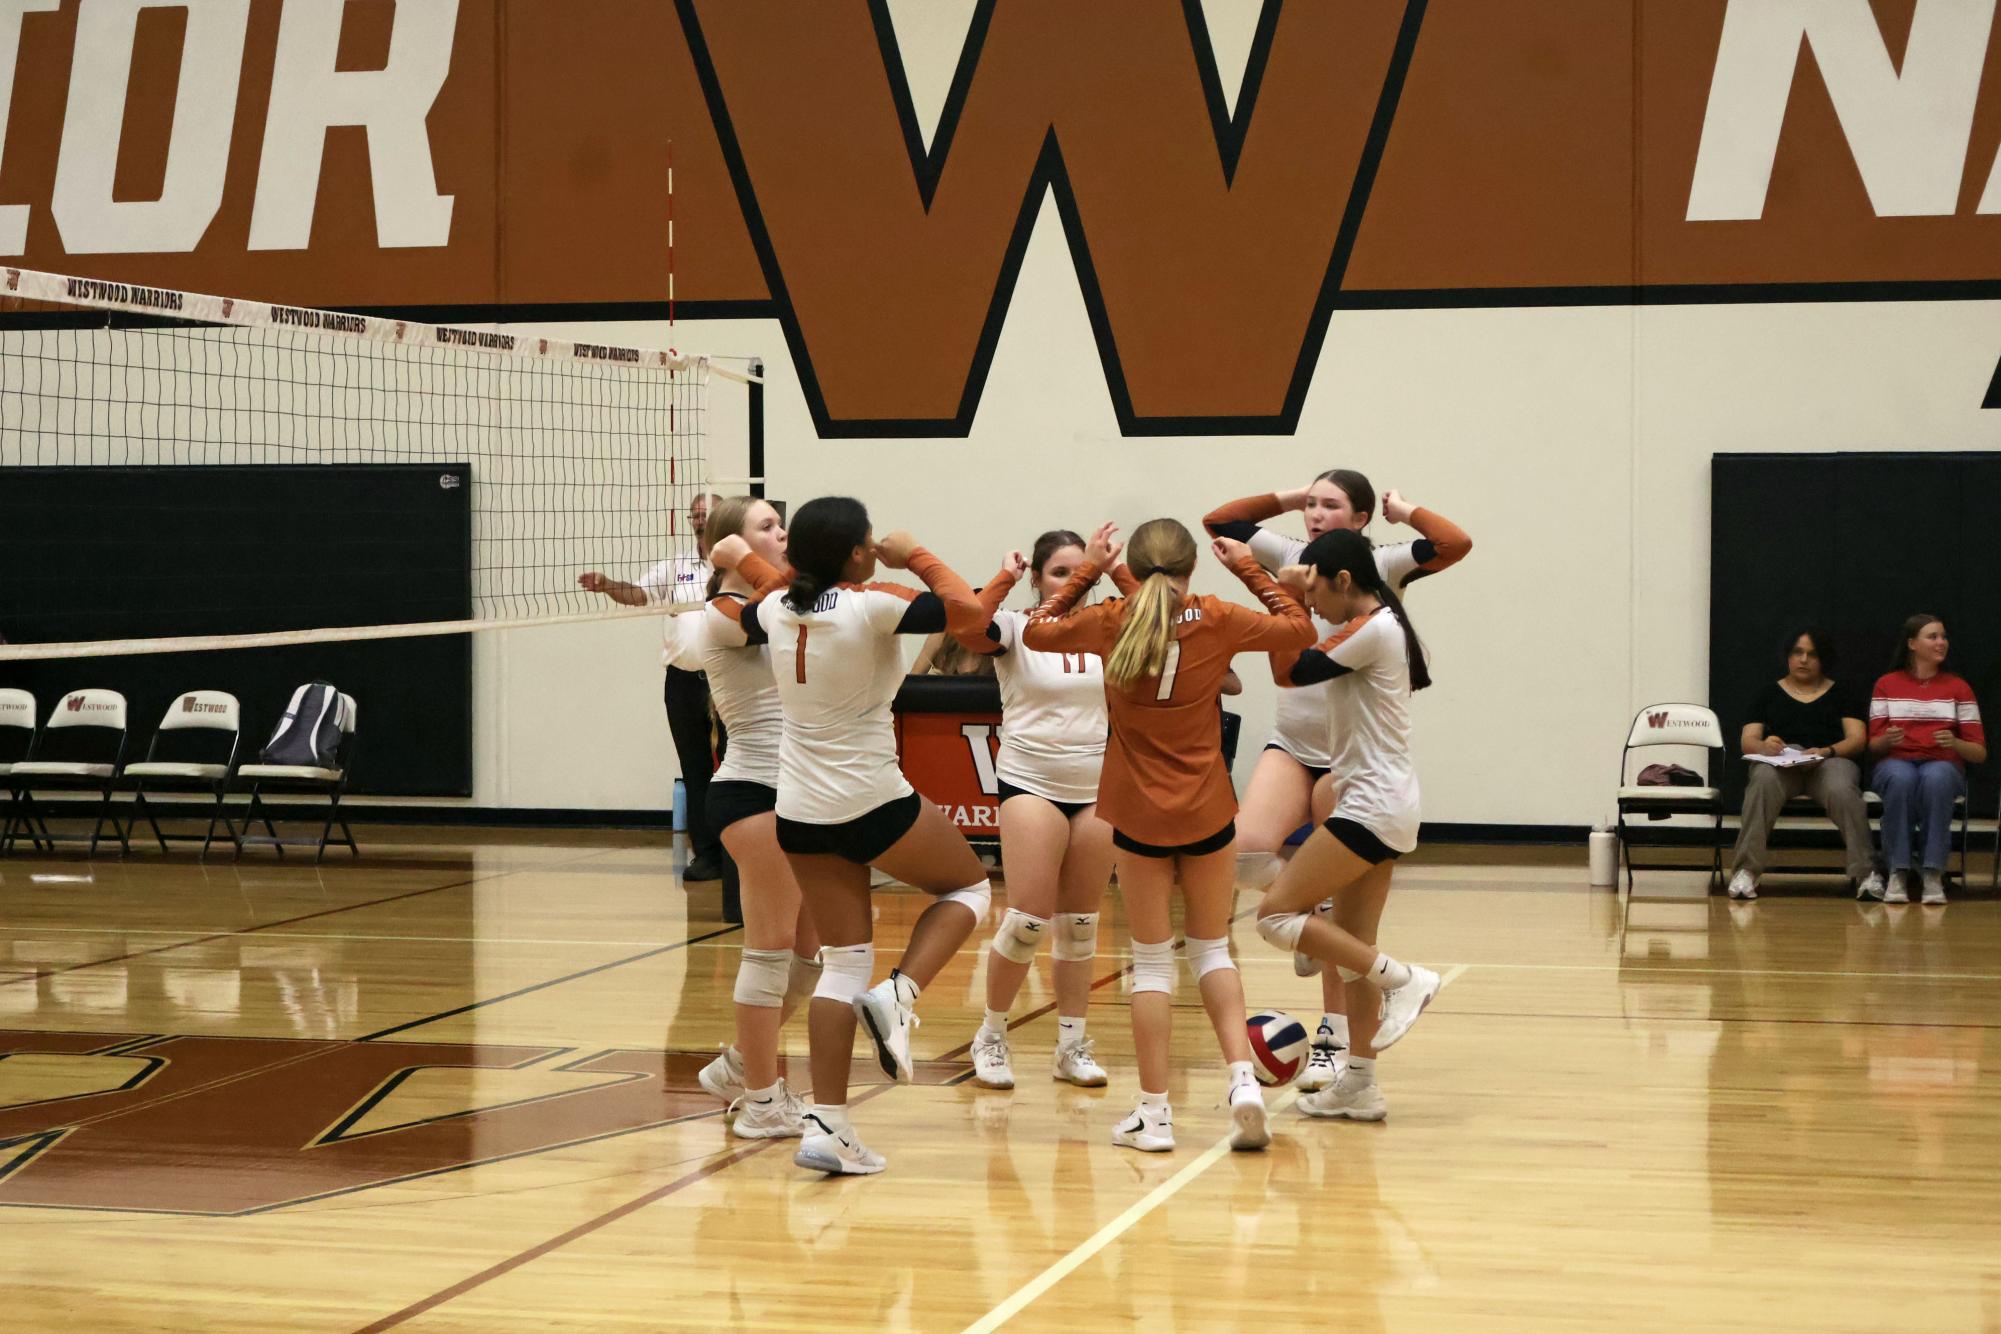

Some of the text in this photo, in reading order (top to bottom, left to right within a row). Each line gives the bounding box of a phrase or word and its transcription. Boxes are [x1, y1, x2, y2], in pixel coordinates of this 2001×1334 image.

[1685, 0, 2001, 222] N
[67, 277, 183, 310] WESTWOOD WARRIORS
[270, 306, 366, 334] WESTWOOD WARRIORS
[795, 623, 808, 685] 1
